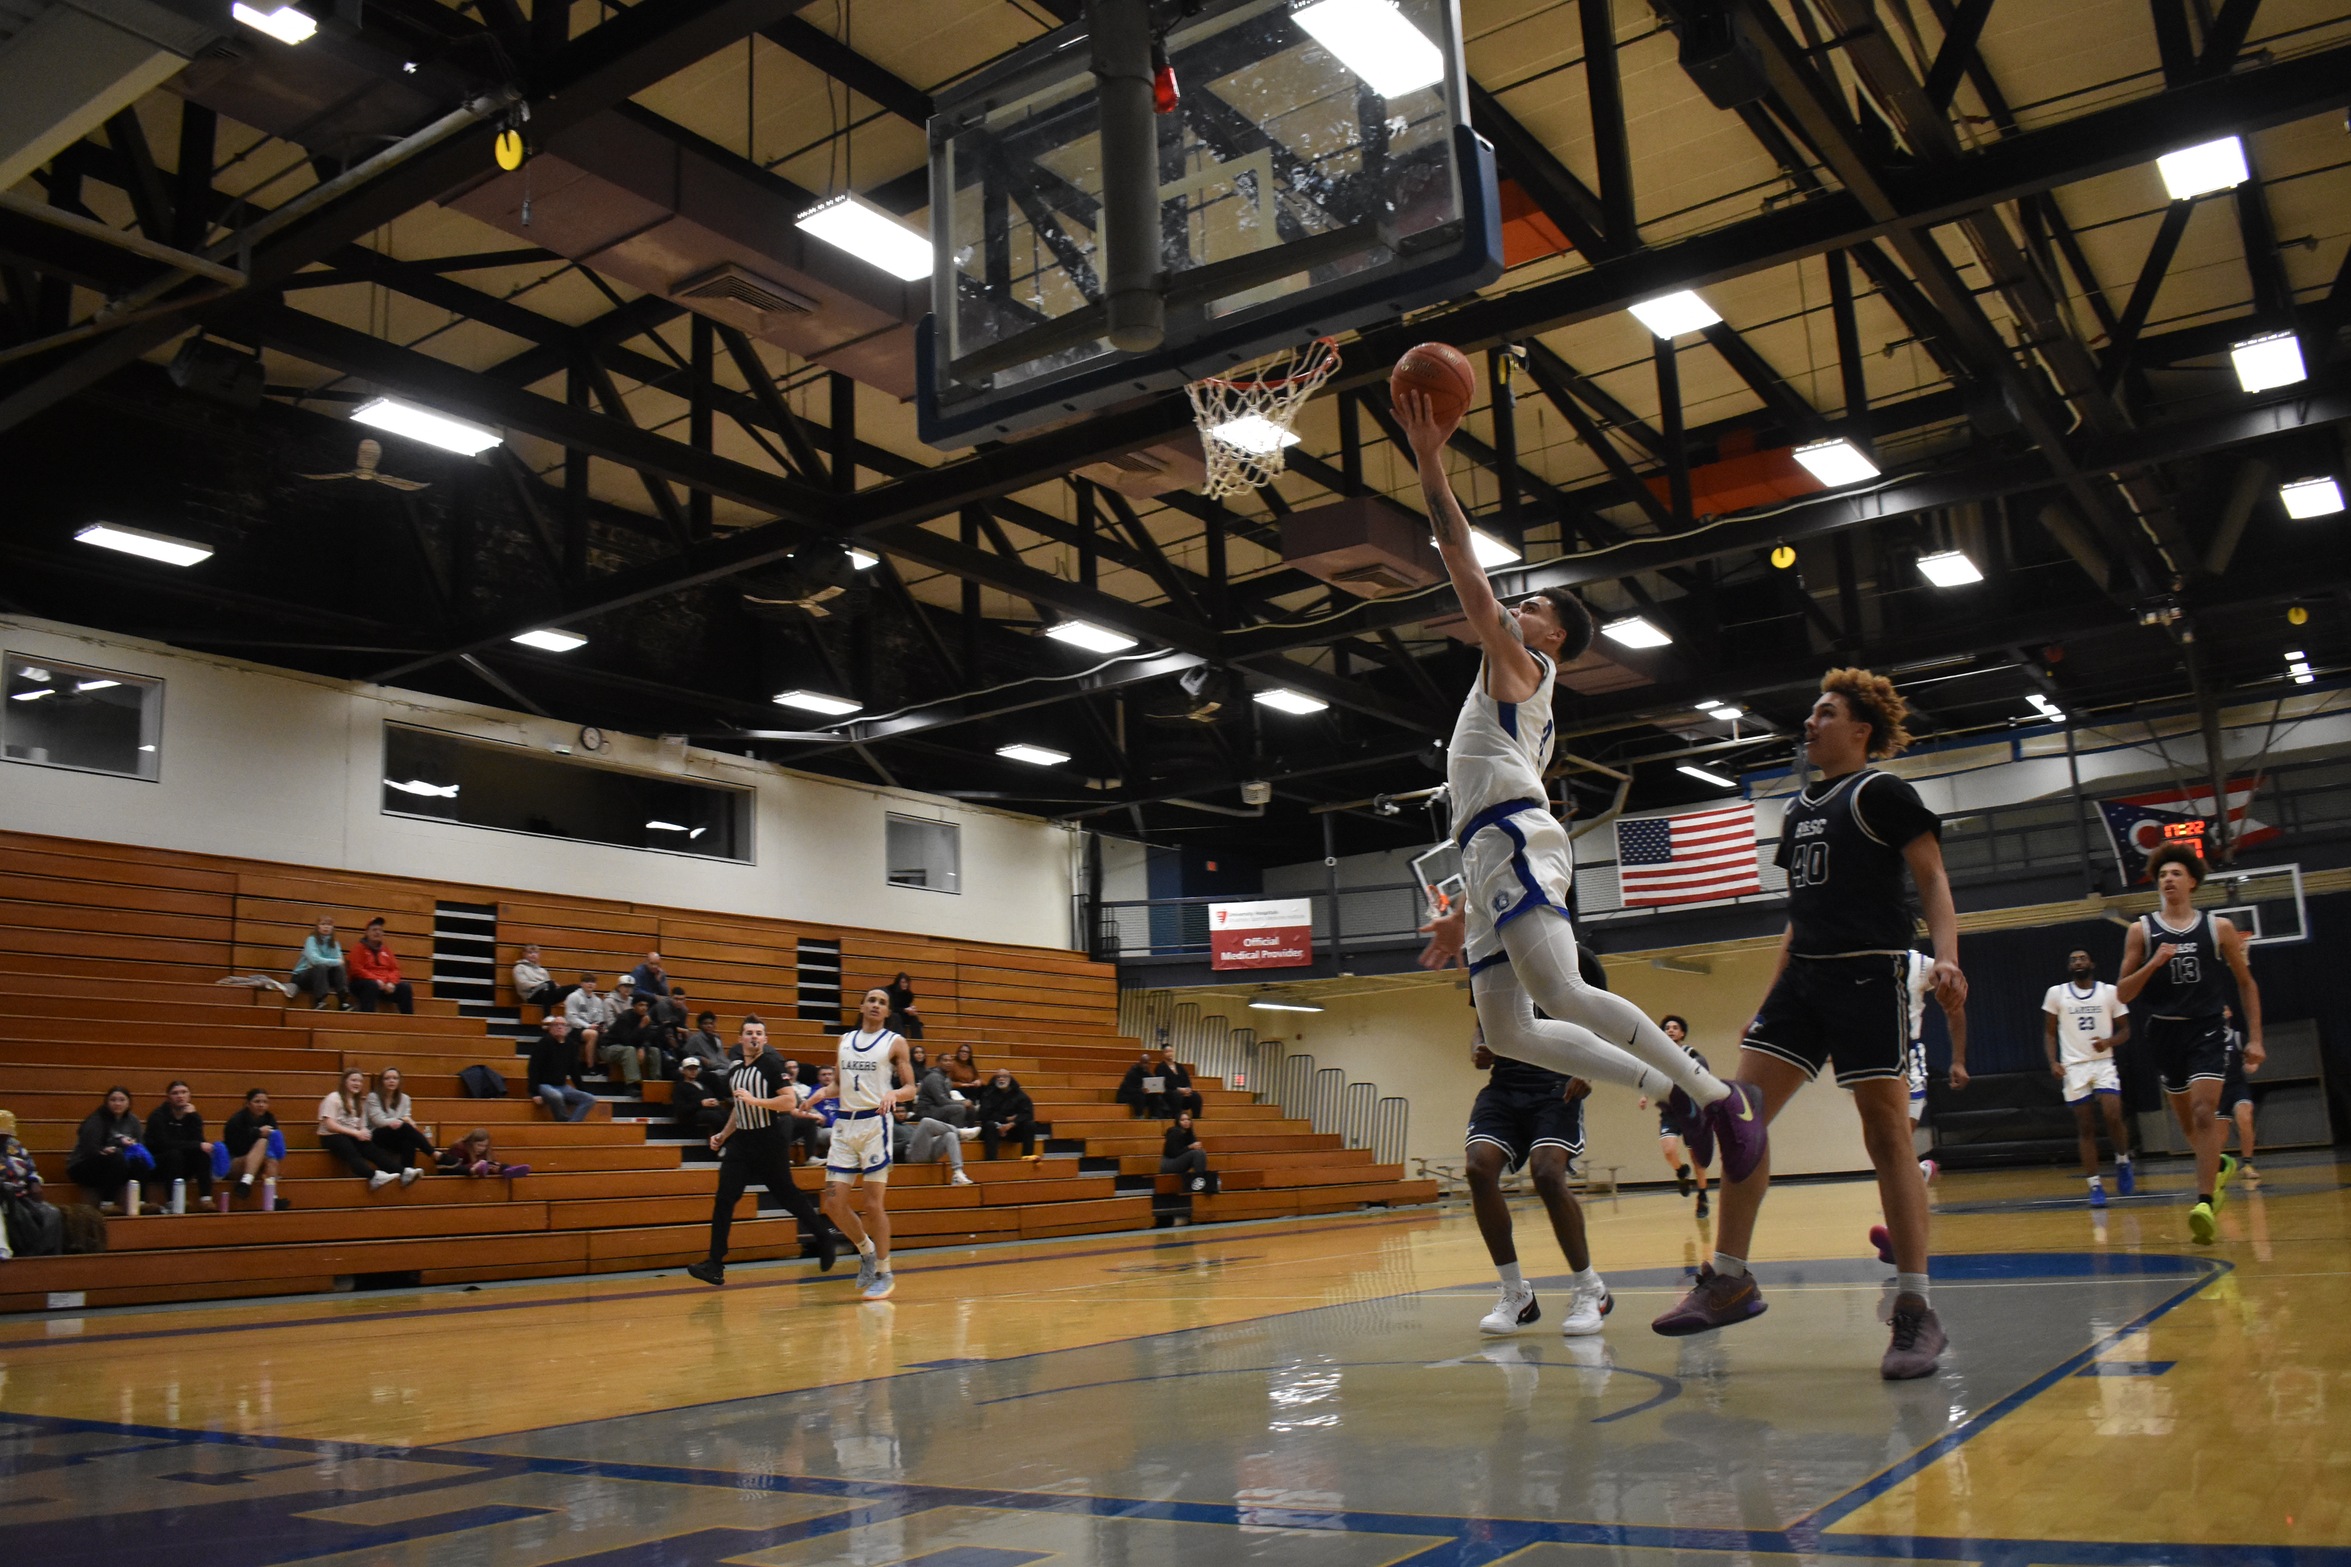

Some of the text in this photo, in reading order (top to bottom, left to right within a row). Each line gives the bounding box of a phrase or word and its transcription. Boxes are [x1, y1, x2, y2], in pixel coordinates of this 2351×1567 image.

[1790, 842, 1830, 888] 40
[1243, 936, 1280, 947] Official
[1220, 947, 1304, 961] Medical Provider
[2169, 956, 2202, 985] 13
[2078, 1016, 2096, 1031] 23
[841, 1060, 877, 1071] LAKERS
[853, 1074, 860, 1092] 1
